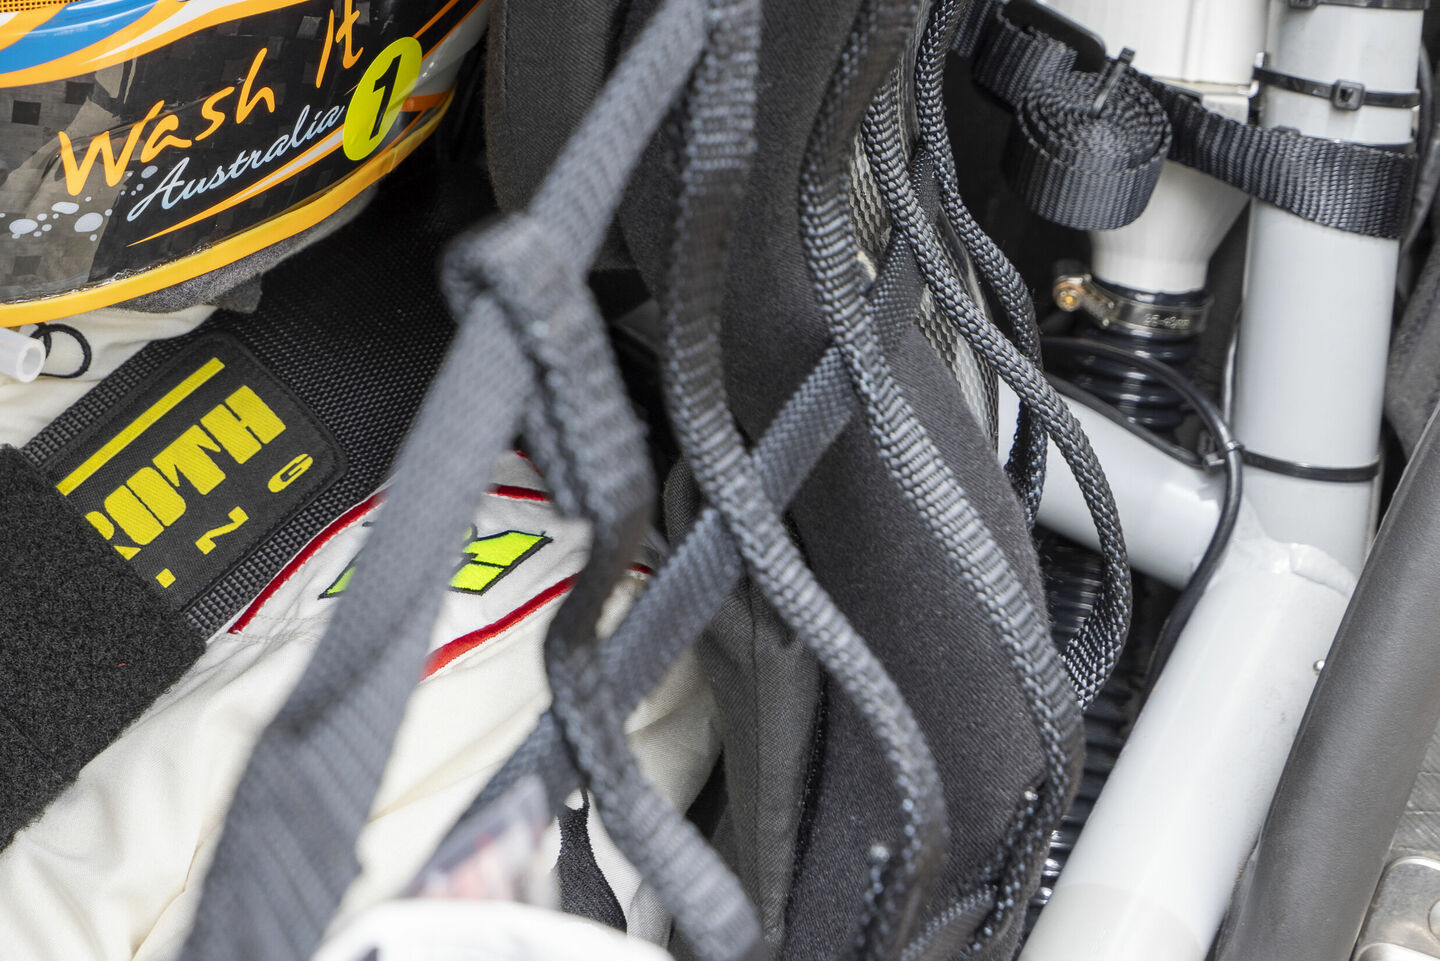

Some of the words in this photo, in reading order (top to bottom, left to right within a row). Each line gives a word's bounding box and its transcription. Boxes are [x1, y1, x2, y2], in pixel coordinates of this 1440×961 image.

[58, 47, 276, 196] Wash
[369, 54, 402, 140] 1
[127, 104, 345, 222] Australia
